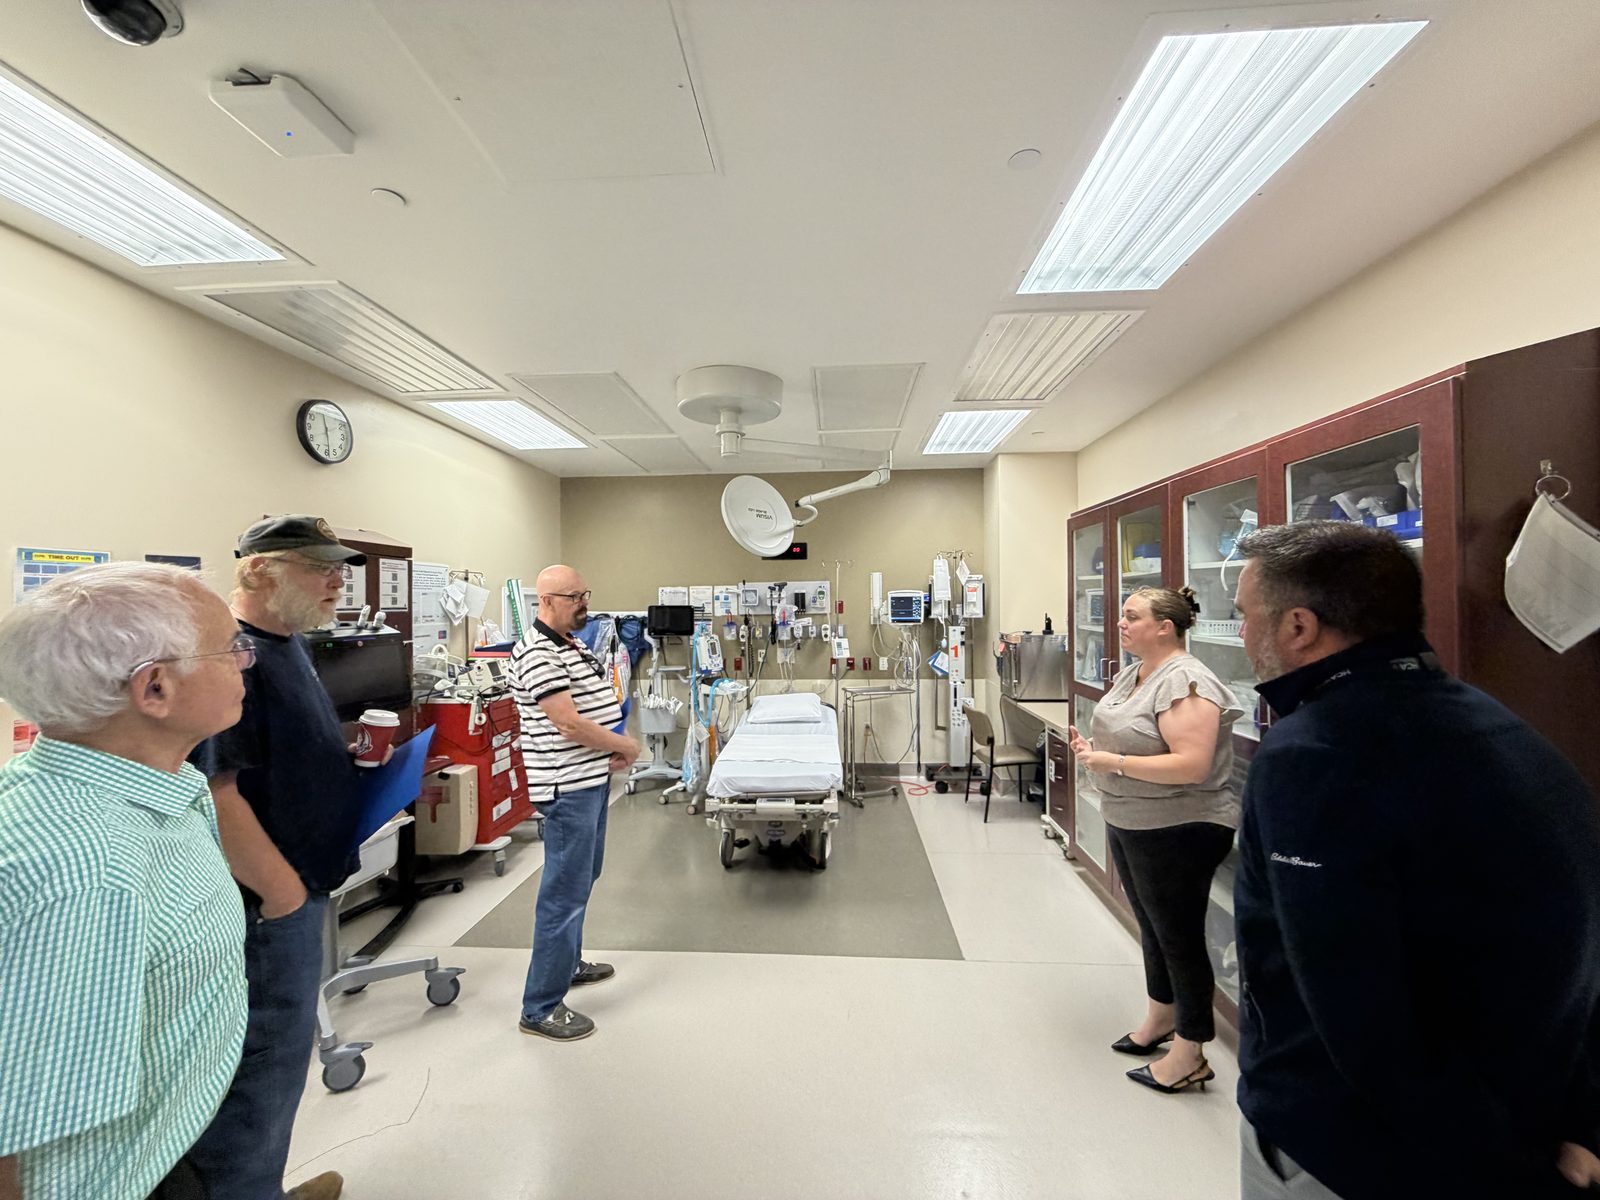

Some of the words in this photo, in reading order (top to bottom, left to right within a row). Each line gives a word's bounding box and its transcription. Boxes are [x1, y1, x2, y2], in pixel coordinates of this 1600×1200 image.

[307, 422, 311, 431] 9
[309, 434, 314, 442] 8
[340, 433, 345, 441] 3
[332, 448, 337, 456] 5
[950, 645, 959, 657] 1
